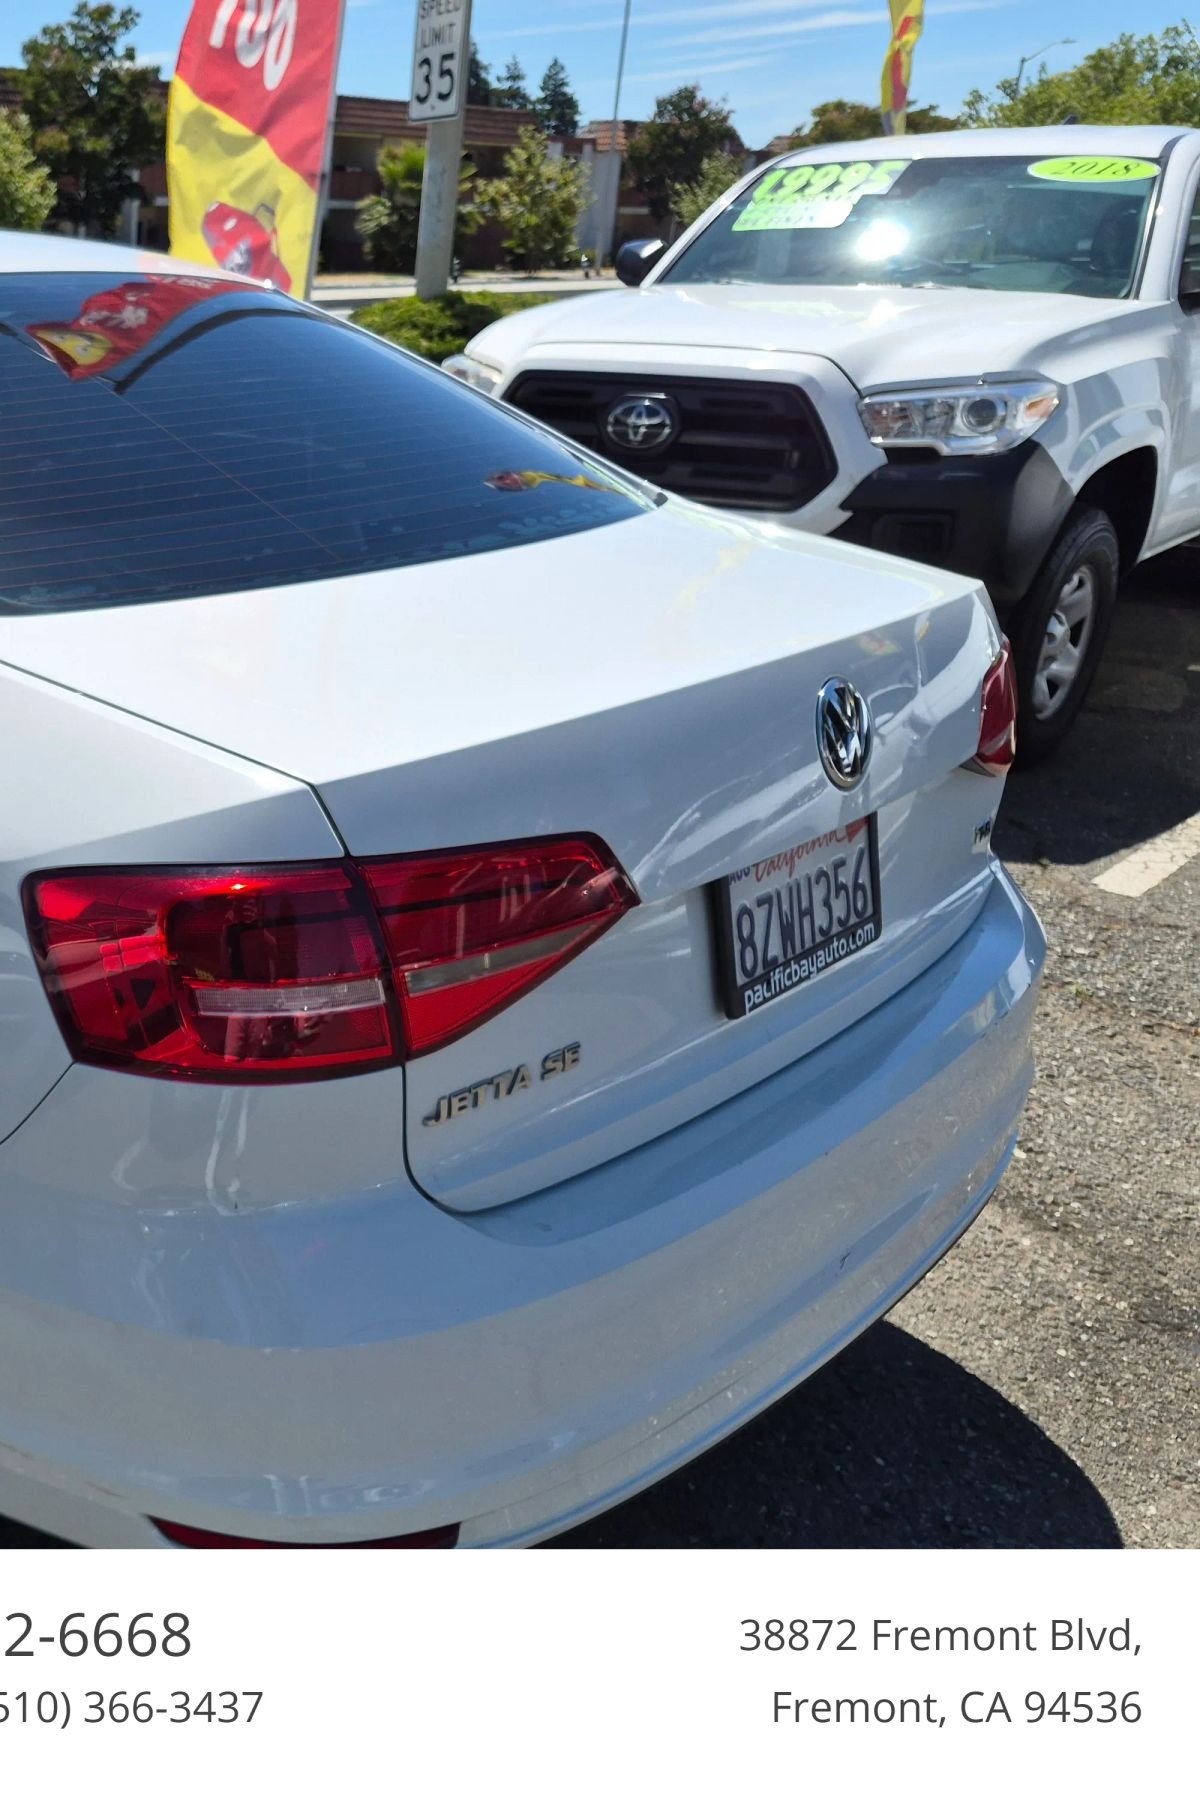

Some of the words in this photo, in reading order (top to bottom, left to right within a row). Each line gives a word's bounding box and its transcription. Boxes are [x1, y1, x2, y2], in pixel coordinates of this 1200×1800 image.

[421, 23, 455, 48] LIMIT
[415, 52, 455, 105] 35
[752, 160, 904, 202] 19995
[1050, 161, 1141, 176] 2018
[736, 843, 873, 980] 8ZWH356
[744, 921, 876, 1015] pacificbayauto.com
[422, 1063, 532, 1126] JETTA
[540, 1041, 582, 1081] SE
